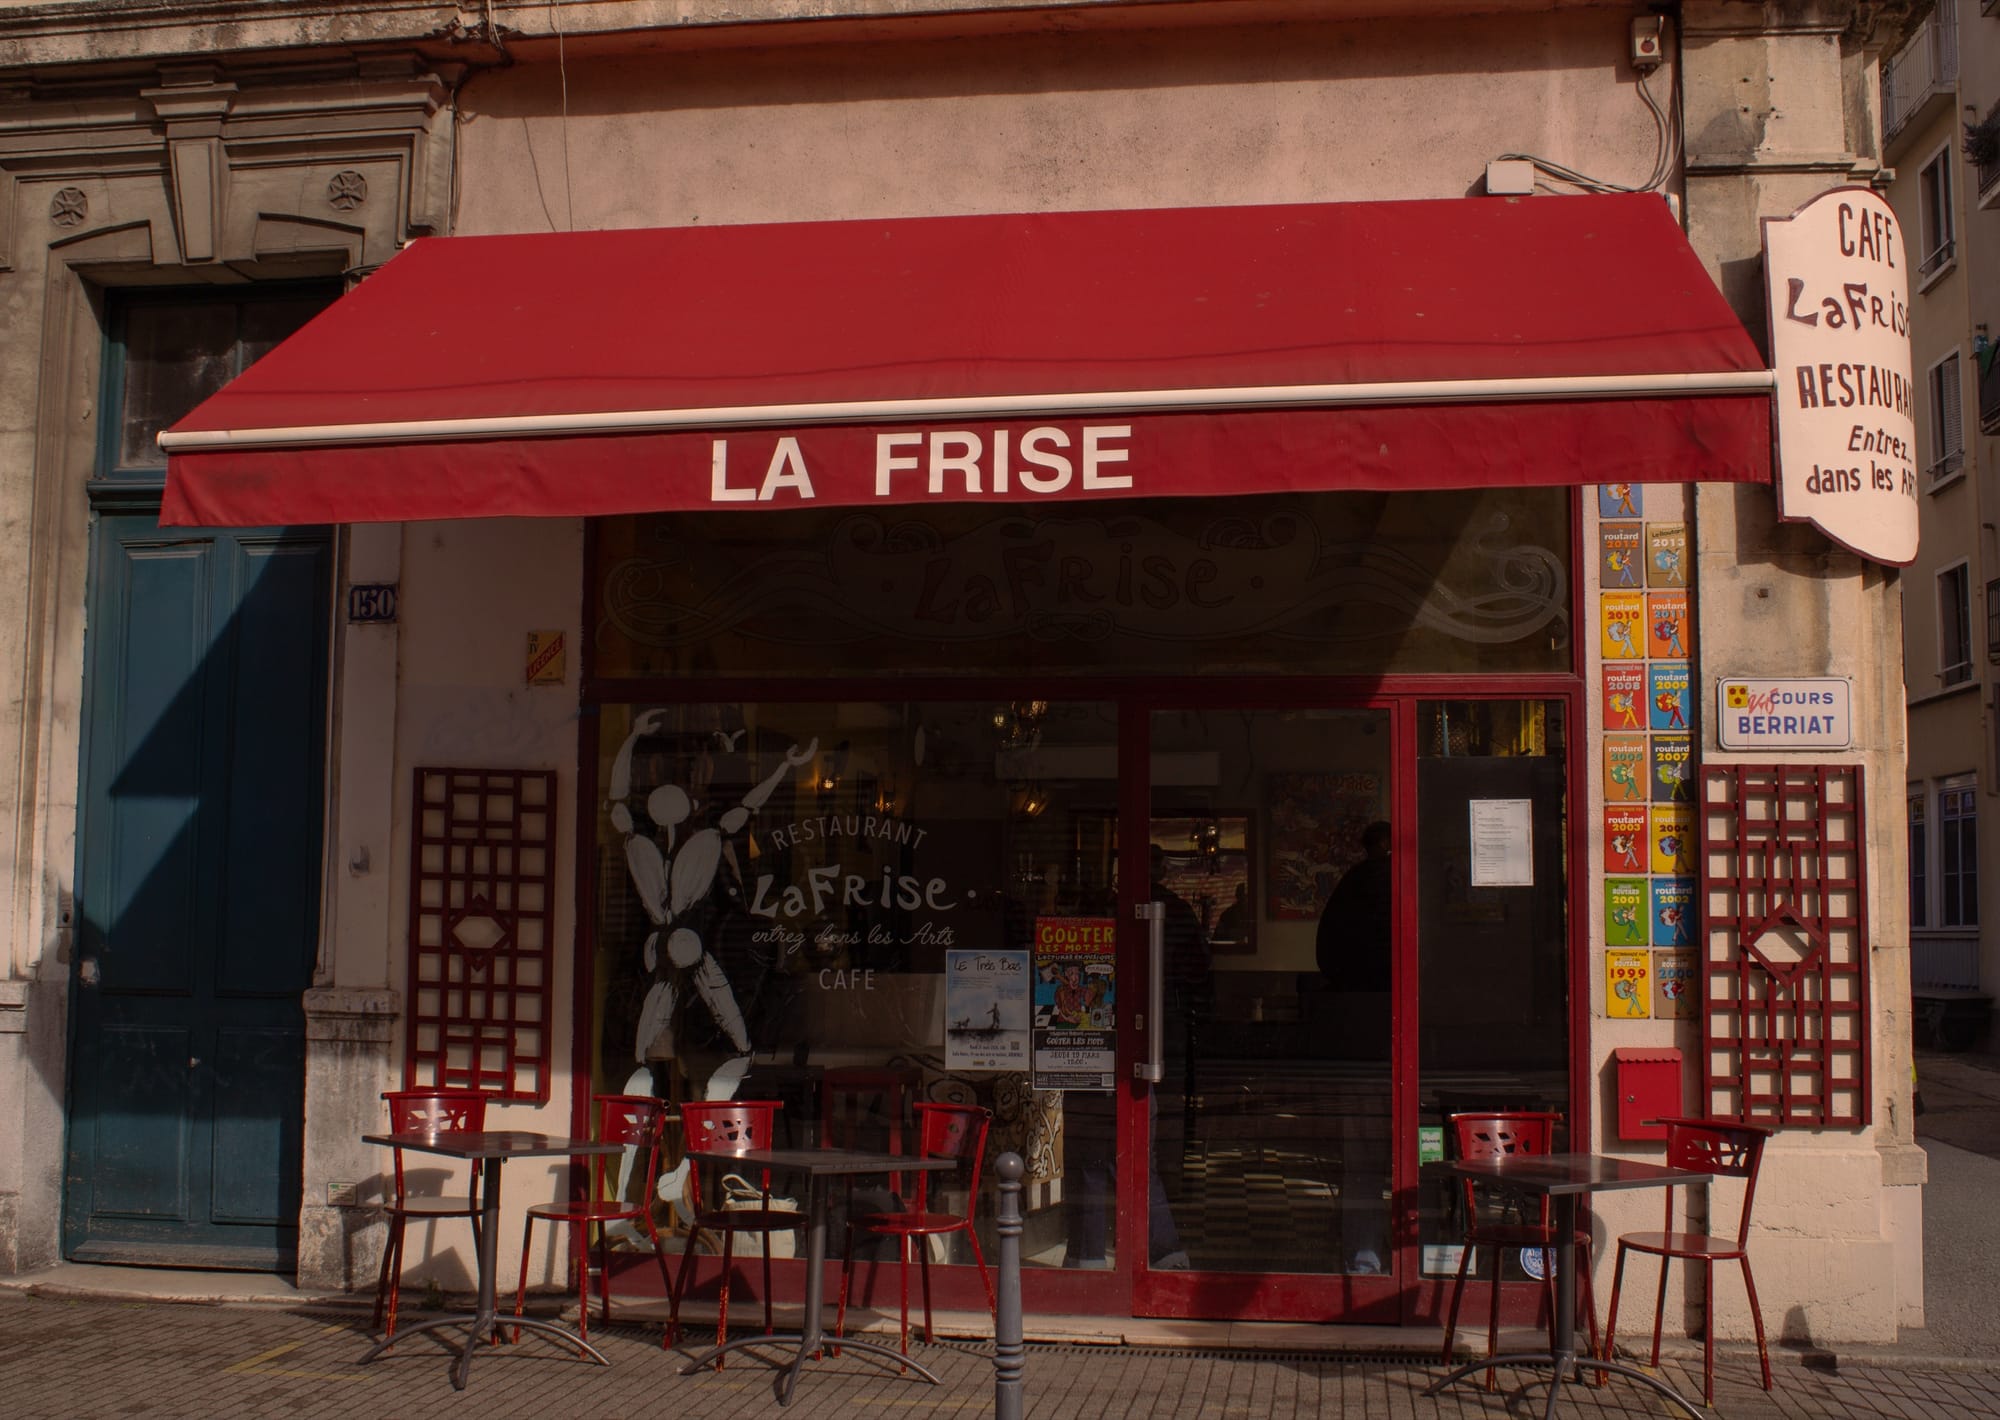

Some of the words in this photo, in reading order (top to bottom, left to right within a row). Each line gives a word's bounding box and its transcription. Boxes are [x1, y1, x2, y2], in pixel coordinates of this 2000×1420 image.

[1838, 203, 1895, 268] CAFE
[711, 437, 816, 501] LA
[875, 425, 1133, 496] FRISE
[1806, 464, 1861, 494] dans
[1870, 460, 1894, 491] les
[1604, 532, 1639, 540] routard
[1607, 540, 1638, 548] 2012
[1652, 538, 1686, 547] 2013
[351, 589, 395, 618] 150
[1605, 603, 1640, 611] routard
[1652, 602, 1687, 610] routard
[1607, 611, 1640, 620] 2010
[1655, 610, 1686, 619] 2011
[1607, 674, 1641, 682] routard
[1654, 673, 1689, 681] routard
[1608, 682, 1640, 690] 2008
[1656, 681, 1688, 690] 2009
[1770, 692, 1834, 705] COURS
[1738, 716, 1835, 735] BERRIAT
[1655, 744, 1690, 752] routard
[1656, 753, 1689, 761] 2007
[1608, 816, 1644, 824] routard
[1612, 823, 1641, 832] 2003
[1659, 824, 1689, 832] 2004
[771, 815, 928, 852] RESTAURANT
[1655, 886, 1693, 895] routard
[1612, 896, 1640, 904] 2001
[1659, 895, 1689, 904] 2002
[751, 924, 806, 954] entrez
[814, 924, 861, 945] dans
[867, 924, 895, 945] les
[899, 921, 955, 946] Arts
[1038, 944, 1060, 952] LES
[1610, 968, 1646, 979] 1999
[1659, 968, 1694, 979] 2000
[819, 968, 876, 991] CAFE
